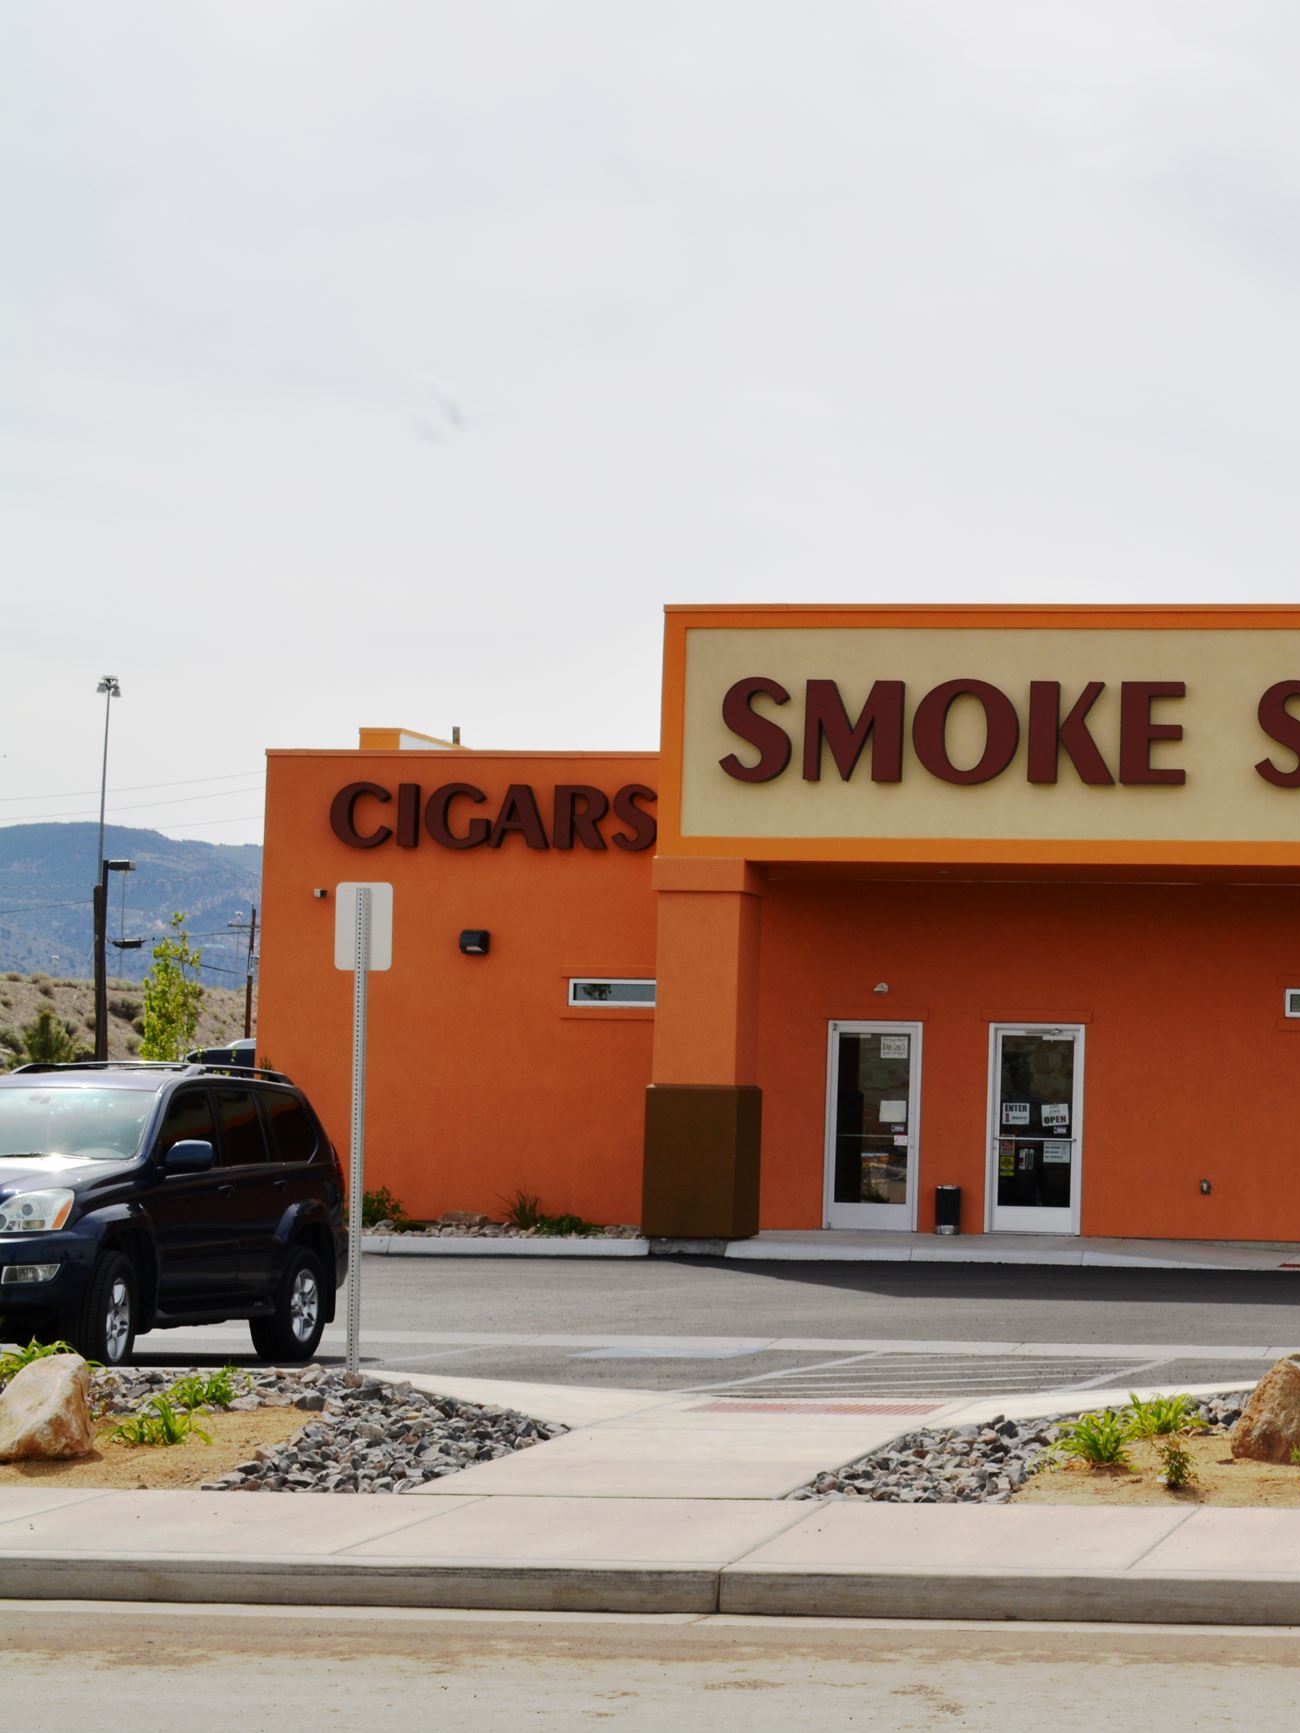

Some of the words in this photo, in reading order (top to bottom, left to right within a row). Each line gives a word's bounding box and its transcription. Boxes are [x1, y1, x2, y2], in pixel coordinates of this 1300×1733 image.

[719, 676, 1186, 786] SMOKE
[330, 781, 658, 850] CIGARS
[1004, 1104, 1028, 1113] ENTER
[1043, 1115, 1067, 1125] OPEN
